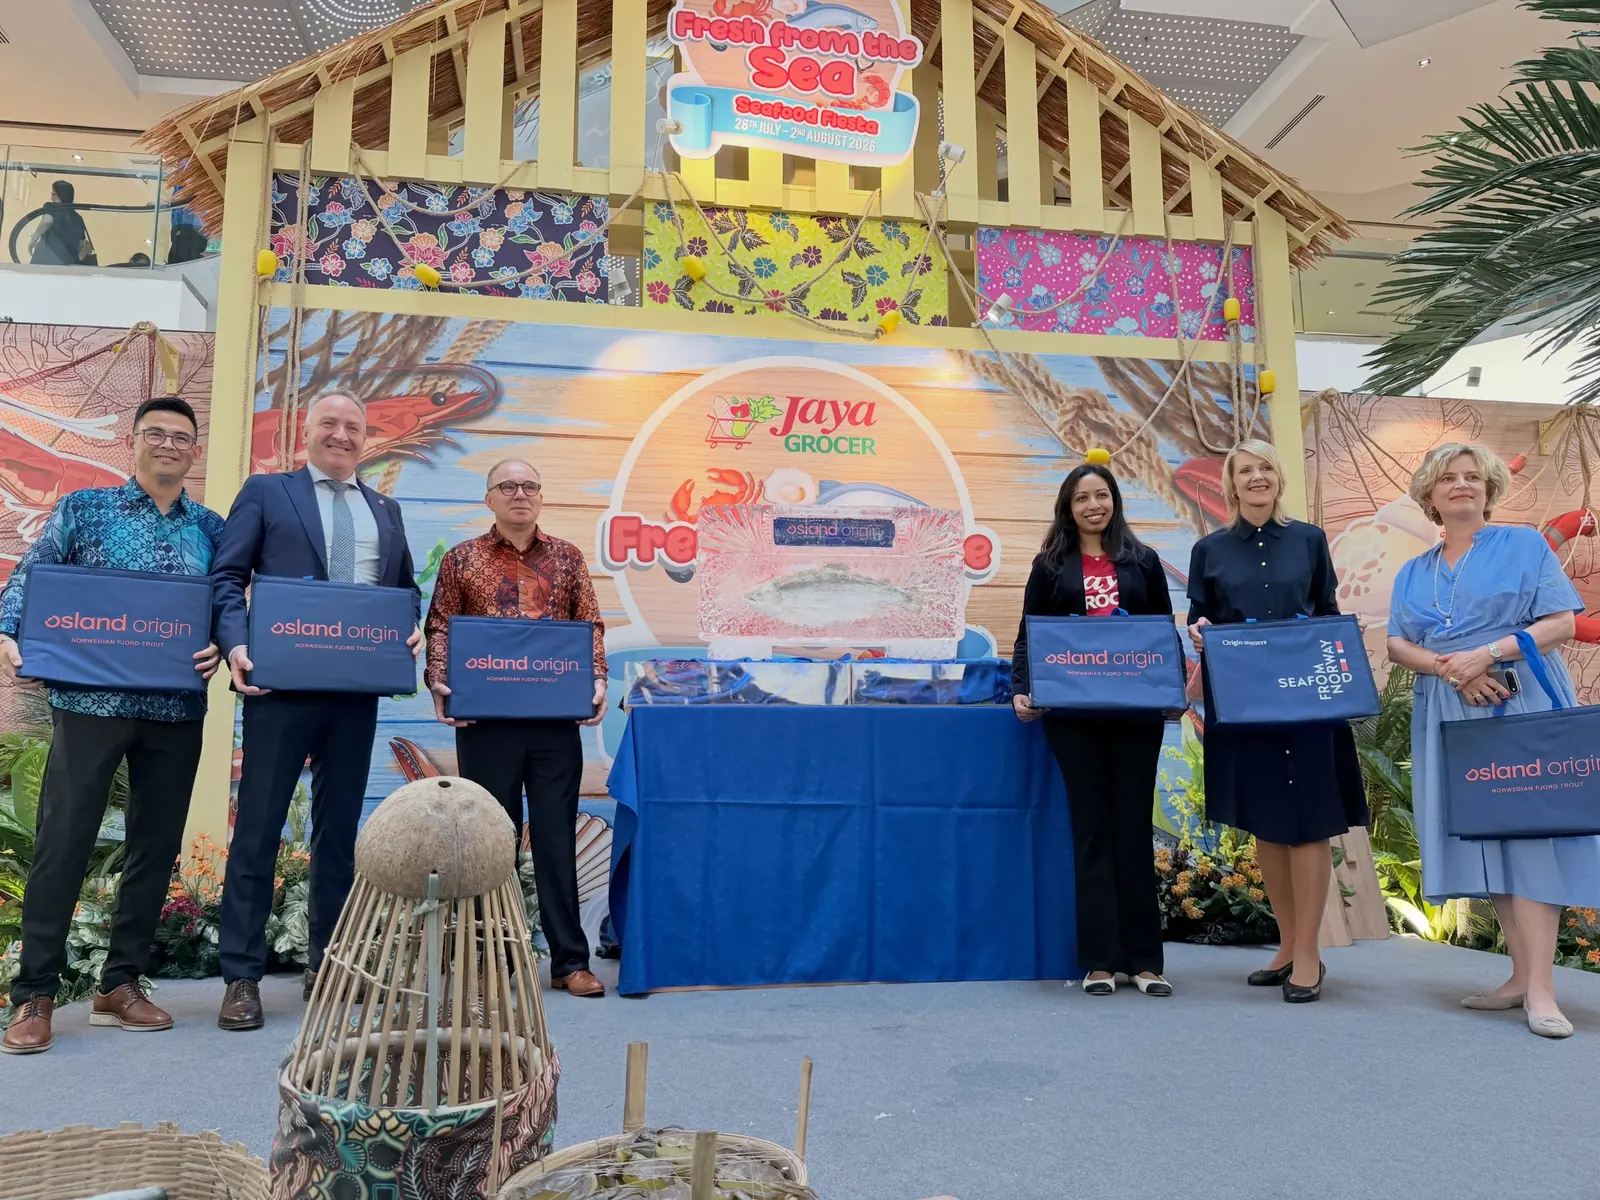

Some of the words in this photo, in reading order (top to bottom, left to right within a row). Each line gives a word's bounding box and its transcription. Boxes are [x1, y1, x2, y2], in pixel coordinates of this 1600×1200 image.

[674, 10, 765, 45] Fresh
[769, 21, 860, 55] from
[862, 32, 917, 61] the
[748, 45, 856, 96] Sea
[735, 95, 819, 125] Seafood
[820, 109, 879, 135] Fiesta
[758, 121, 781, 136] JULY
[806, 130, 848, 148] AUGUST
[848, 136, 877, 152] 2026
[769, 396, 877, 437] Jaya
[784, 433, 877, 456] GROCER
[609, 515, 698, 564] Fre
[1085, 591, 1119, 611] ROC
[132, 617, 192, 639] origin
[347, 624, 399, 644] origin
[70, 637, 116, 645] NORWEGIAN
[117, 639, 140, 647] FJORD
[141, 640, 165, 648] TROUT
[295, 642, 334, 650] NORWEGIAN
[1221, 639, 1243, 647] Origin
[532, 657, 579, 675] origin
[1112, 650, 1164, 669] origin
[1278, 672, 1353, 688] SEAFOOD
[1491, 785, 1534, 794] NORWEGIAN
[1535, 783, 1558, 791] FJORD
[1560, 781, 1584, 789] TROUT
